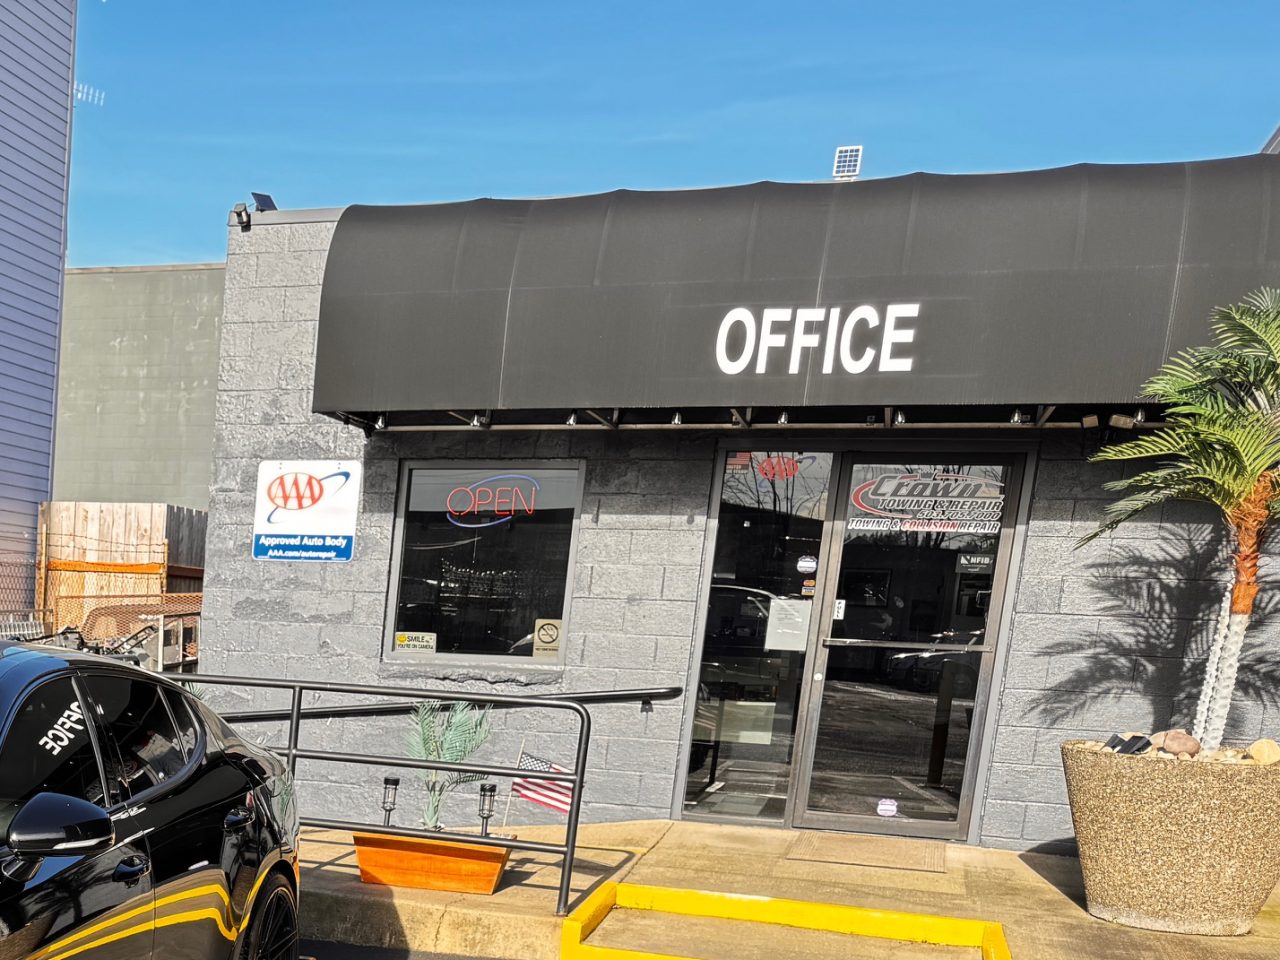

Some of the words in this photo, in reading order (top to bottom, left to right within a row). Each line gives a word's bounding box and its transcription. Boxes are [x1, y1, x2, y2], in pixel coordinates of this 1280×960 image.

[716, 304, 920, 375] OFFICE
[268, 472, 323, 510] AAA
[870, 474, 986, 498] Crown
[447, 487, 535, 515] OPEN
[878, 499, 935, 509] TOWING
[935, 501, 949, 510] &
[949, 500, 1004, 512] REPAIR
[848, 518, 890, 530] TOWING
[890, 519, 900, 530] &
[901, 519, 959, 532] COLLISION
[959, 521, 1001, 533] REPAIR
[259, 536, 300, 547] Approved
[302, 536, 324, 545] Auto
[325, 537, 347, 548] Body
[267, 549, 336, 559] AAA.com/autorepair
[970, 556, 990, 564] NFIB
[407, 635, 425, 643] SMILE
